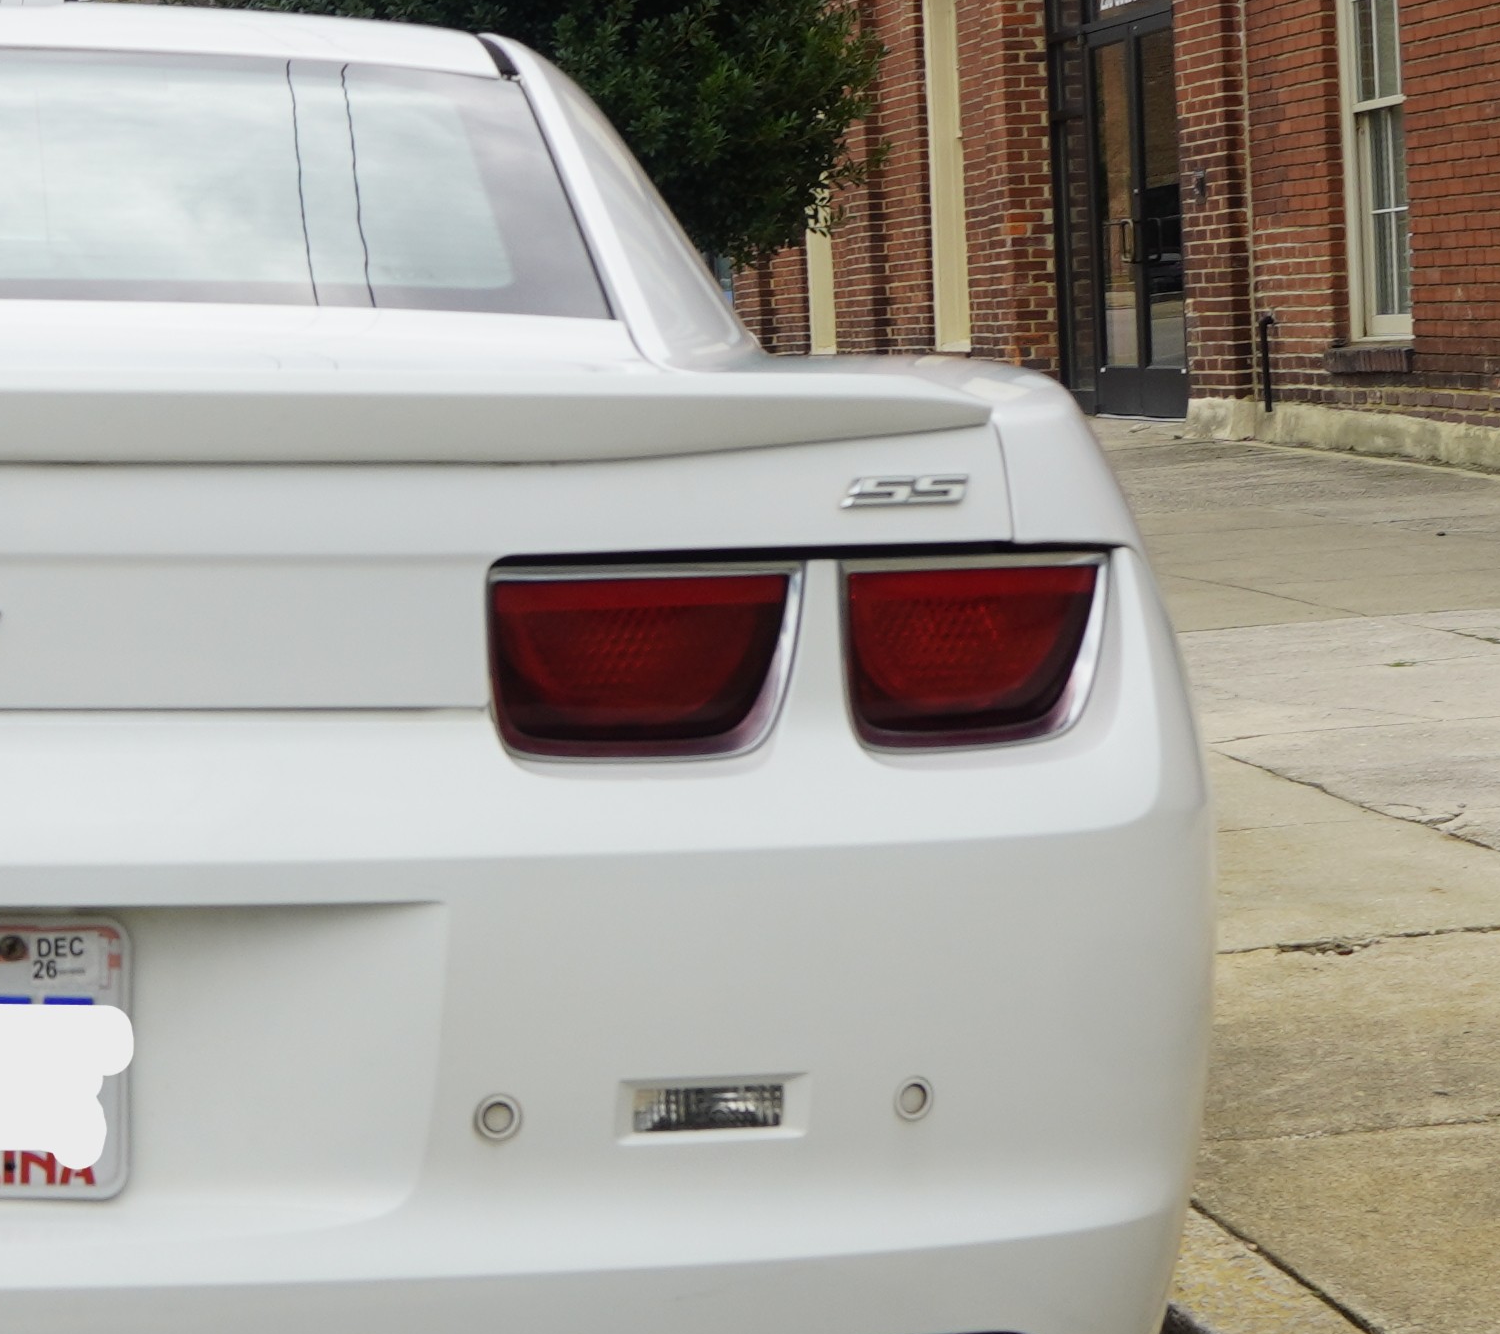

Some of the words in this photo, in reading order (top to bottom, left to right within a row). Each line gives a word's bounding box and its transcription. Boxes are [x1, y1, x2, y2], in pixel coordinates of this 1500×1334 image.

[840, 473, 969, 509] SS
[36, 936, 84, 958] DEC
[33, 959, 57, 979] 26
